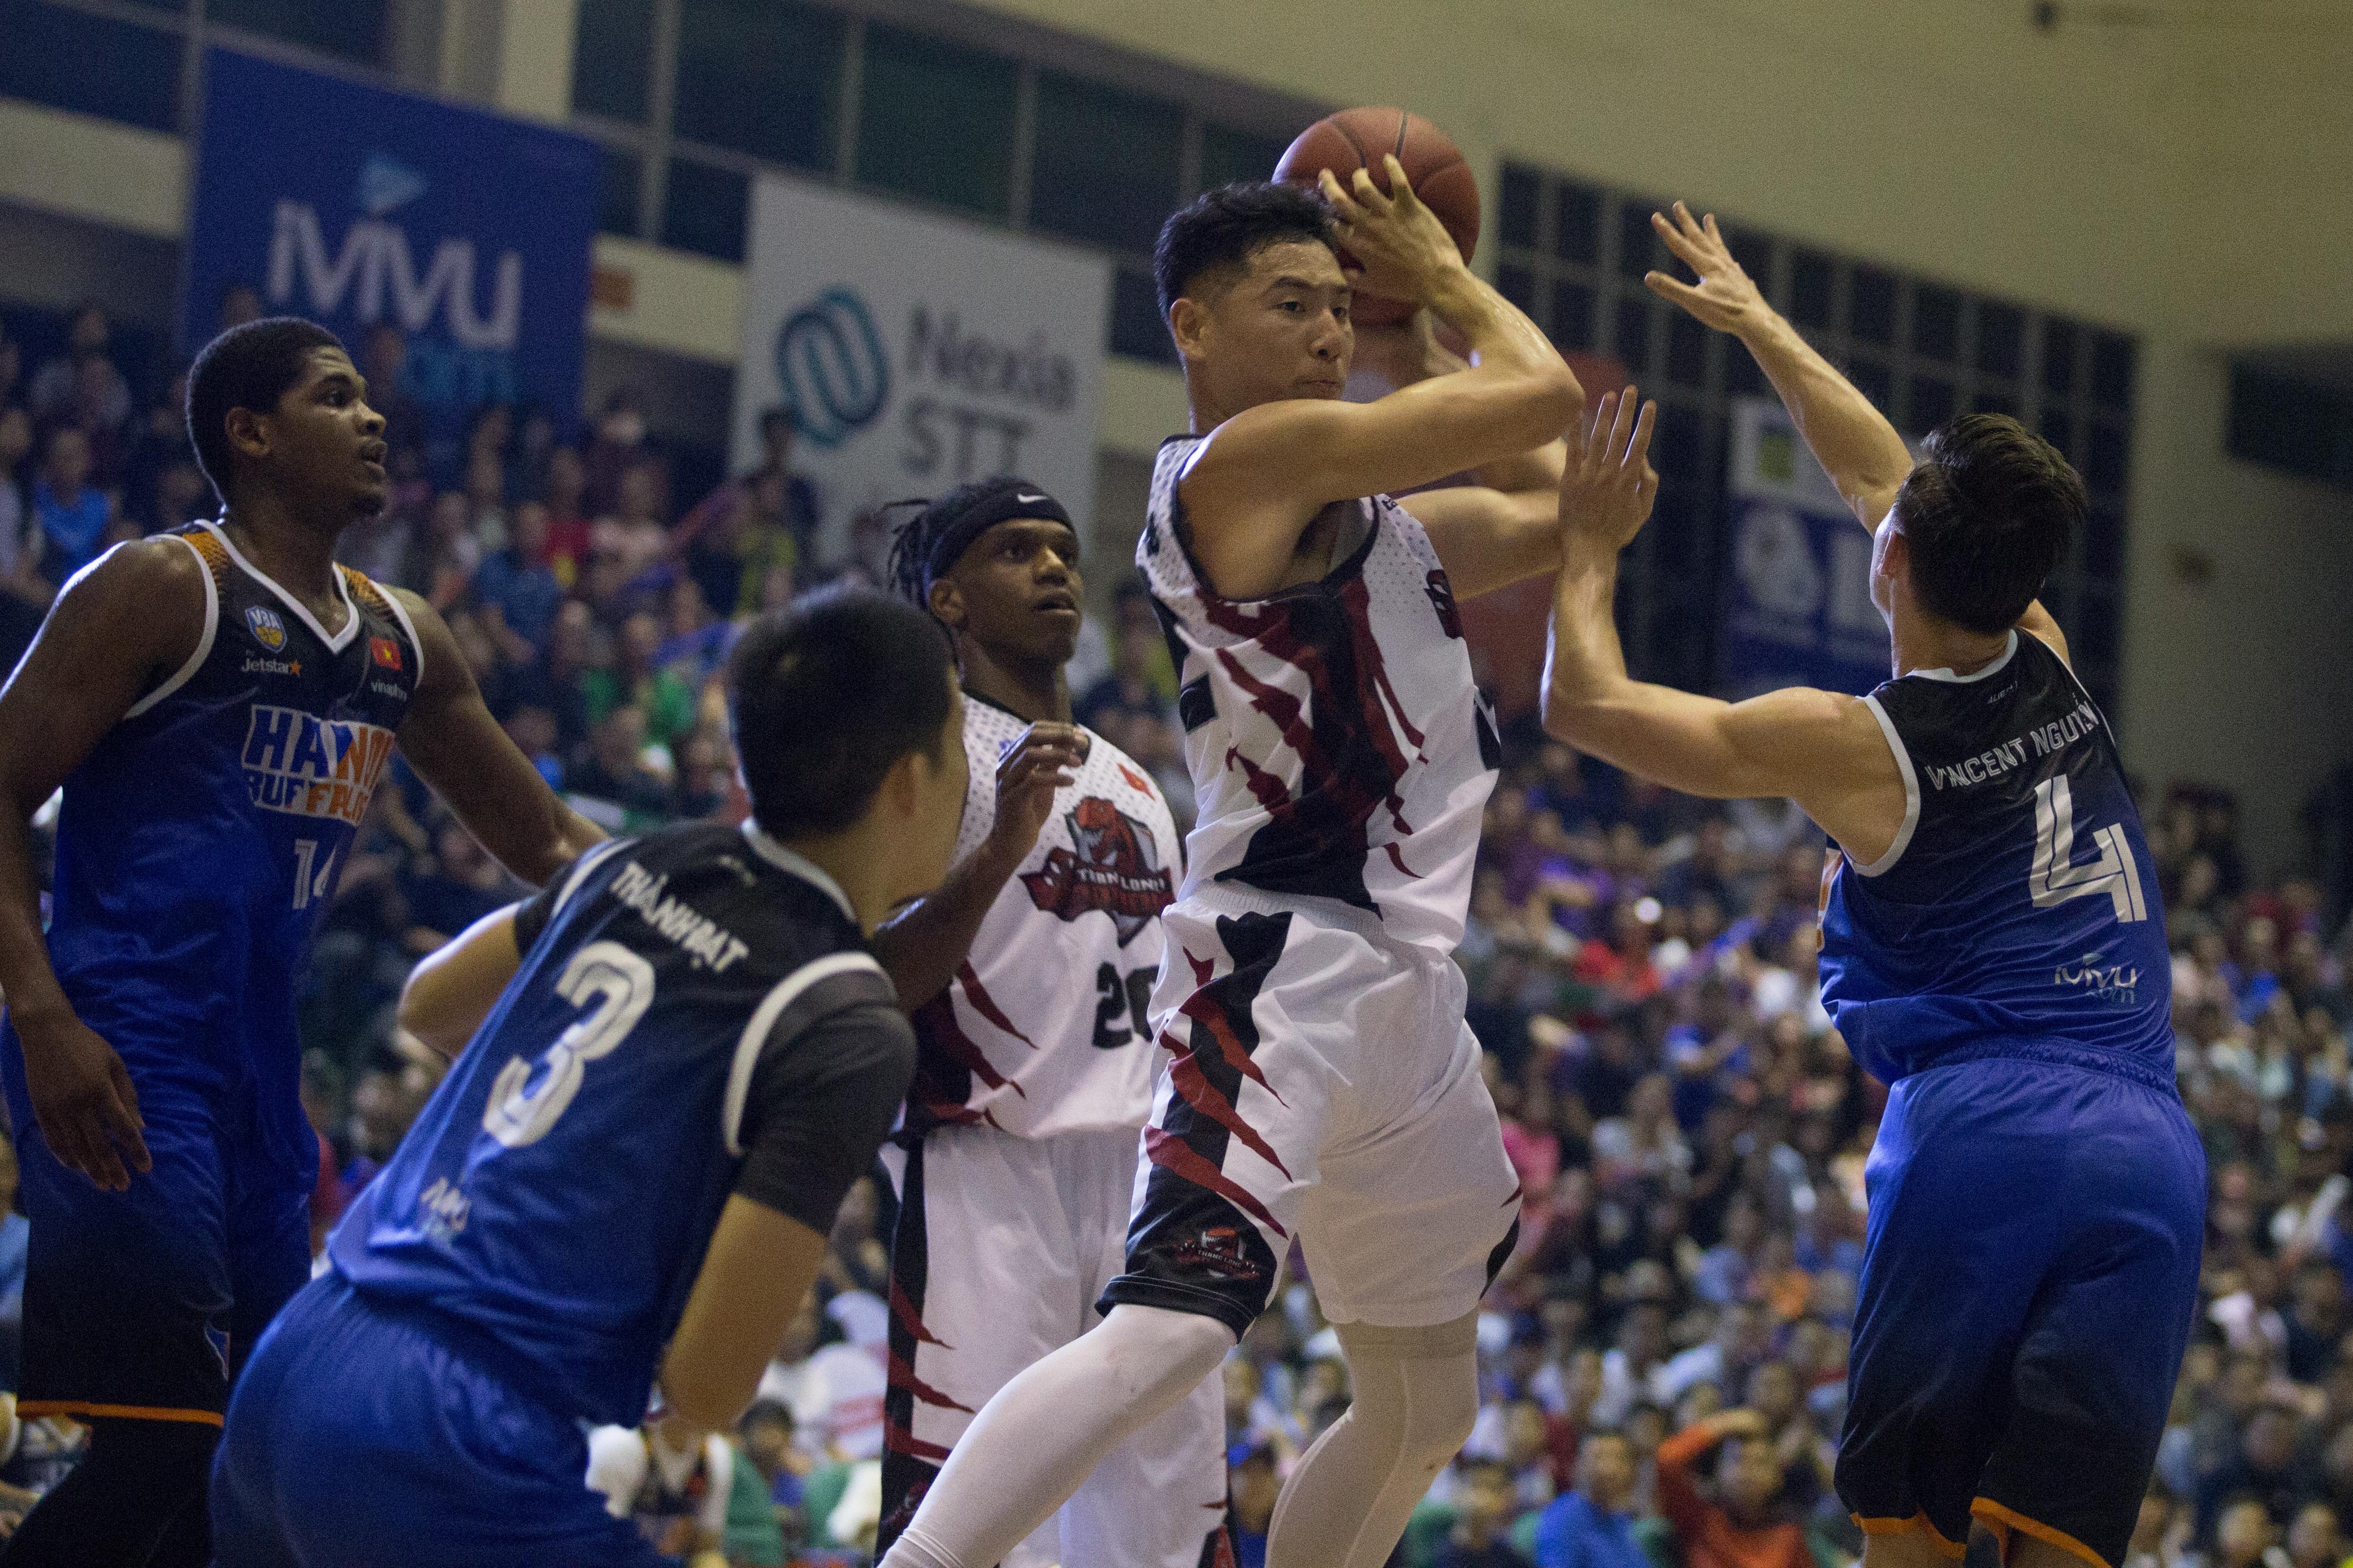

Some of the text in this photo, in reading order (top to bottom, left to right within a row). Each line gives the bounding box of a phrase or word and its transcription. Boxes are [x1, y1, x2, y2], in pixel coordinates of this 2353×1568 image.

[241, 658, 289, 674] Jetstar
[1925, 737, 2027, 790] VNCENT
[2029, 774, 2148, 923] 4
[482, 940, 656, 1148] 3
[1091, 962, 1160, 1049] 20
